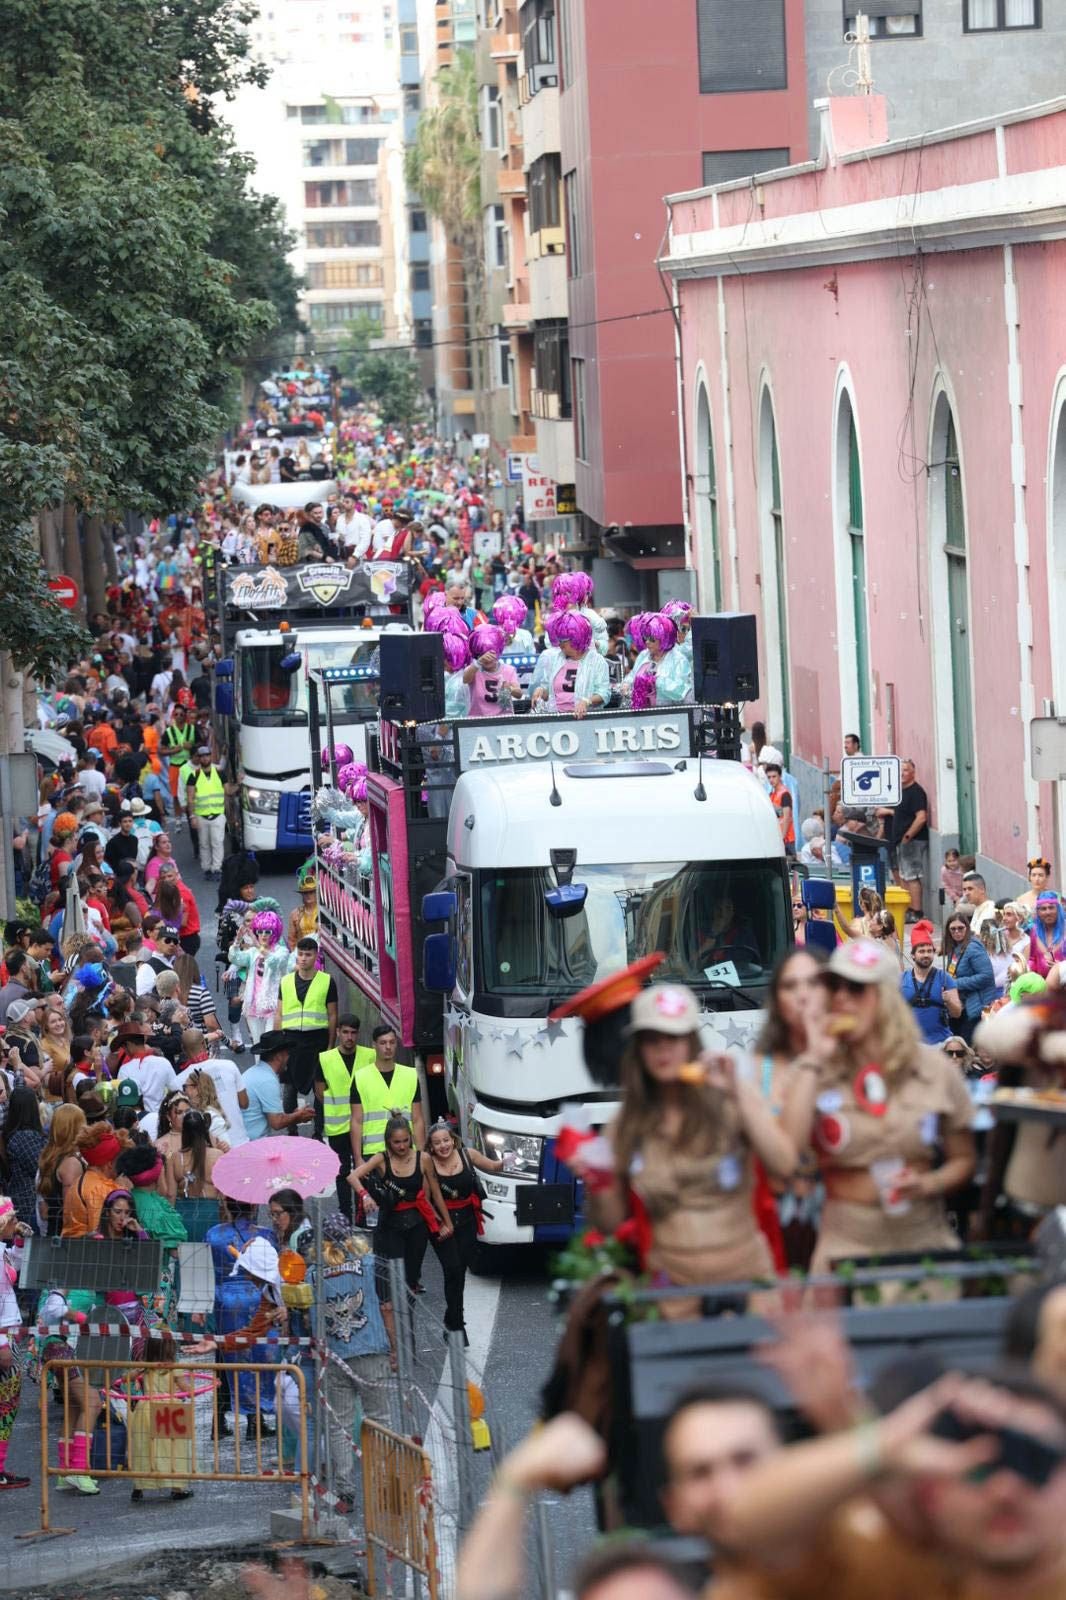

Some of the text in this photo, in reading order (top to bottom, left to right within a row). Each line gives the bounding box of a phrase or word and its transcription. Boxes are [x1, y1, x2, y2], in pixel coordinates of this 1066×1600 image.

[484, 680, 499, 703] 5
[562, 669, 577, 693] 5
[469, 723, 681, 763] ARCO IRIS
[861, 866, 873, 881] P
[711, 966, 731, 977] 31
[155, 1406, 187, 1438] HC
